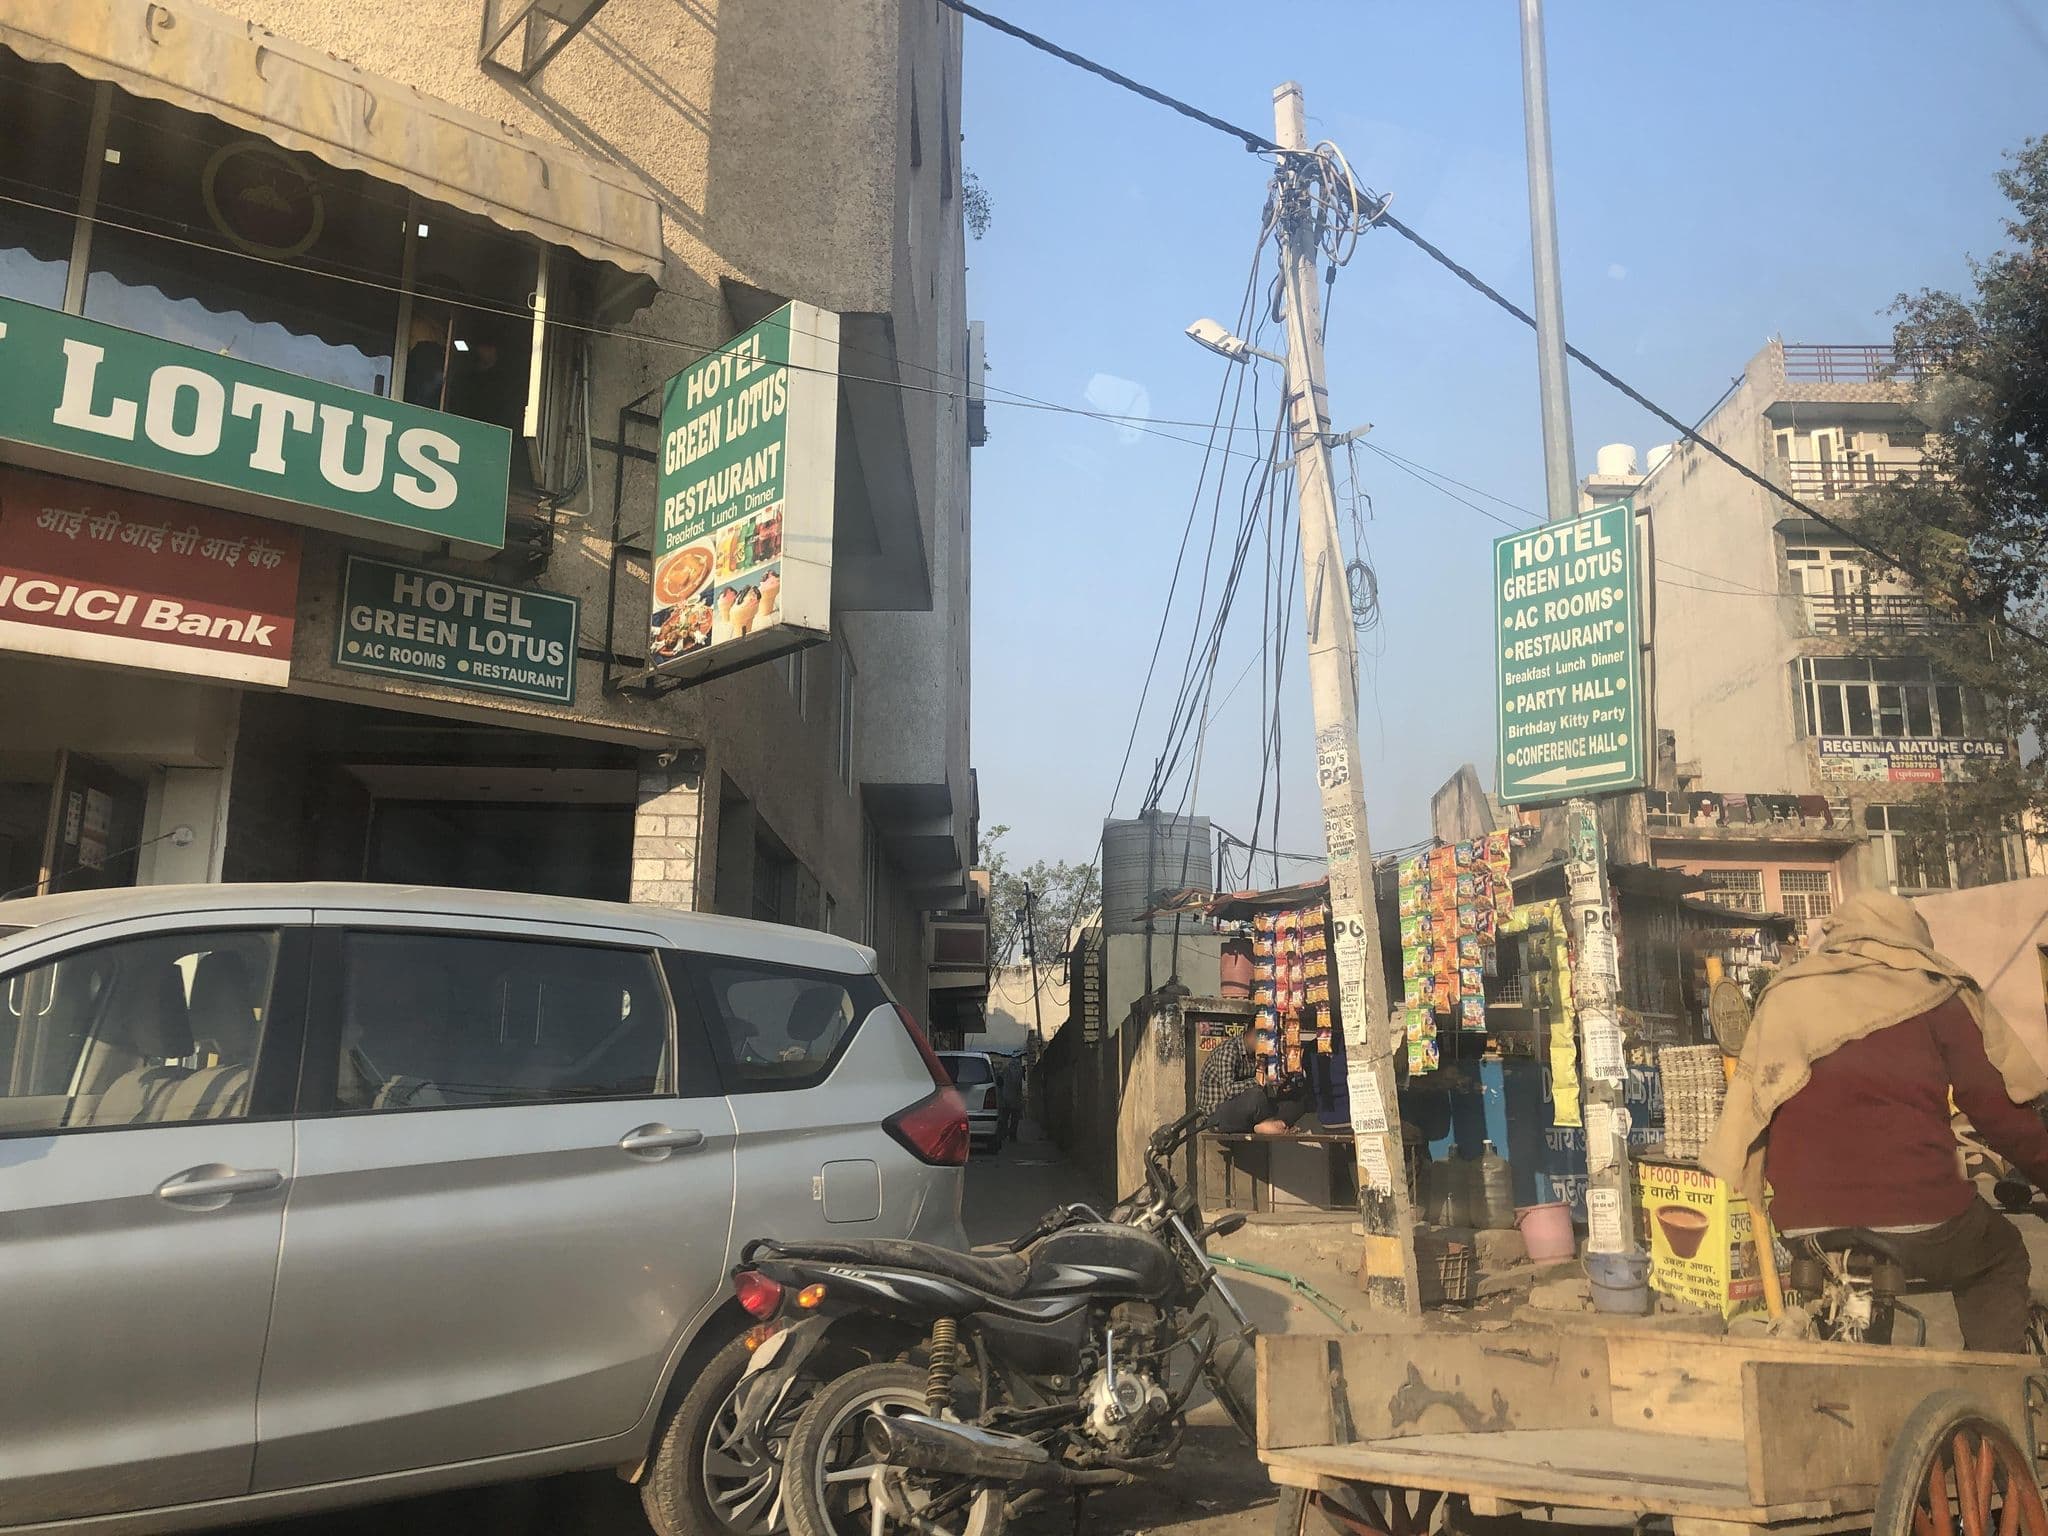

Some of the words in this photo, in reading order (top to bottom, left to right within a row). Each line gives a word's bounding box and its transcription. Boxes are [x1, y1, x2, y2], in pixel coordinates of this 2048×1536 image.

[687, 334, 765, 410] HOTEL
[52, 339, 459, 509] LOTUS
[666, 405, 721, 475] GREEN
[726, 368, 787, 445] LOTUS
[664, 442, 781, 531] RESTAURANT
[666, 519, 705, 549] Breakfast
[711, 503, 738, 527] Lunch
[744, 487, 776, 512] Dinner
[1514, 519, 1611, 569] HOTEL
[1504, 565, 1559, 601] GREEN
[1565, 549, 1622, 586] LOTUS
[0, 576, 138, 625] ICICI
[141, 599, 277, 646] Bank
[393, 573, 532, 628] HOTEL
[1514, 606, 1538, 631] AC
[1545, 586, 1613, 623] ROOMS
[351, 605, 458, 647] GREEN
[468, 627, 564, 666] LOTUS
[1515, 620, 1613, 661] RESTAURANT
[363, 643, 384, 659] AC
[390, 647, 446, 669] ROOMS
[473, 662, 564, 689] RESTAURANT
[1505, 664, 1551, 686] Breakfast
[1556, 656, 1586, 675] Lunch
[1591, 650, 1625, 669] Dinner
[1517, 687, 1566, 714] PARTY
[1572, 678, 1614, 704] HALL
[1508, 717, 1556, 739] Birthday
[1560, 713, 1589, 731] Kitty
[1592, 706, 1626, 725] Party
[1319, 752, 1345, 767] Boy's
[1516, 739, 1586, 767] CONFERENCE
[1589, 731, 1617, 754] HALL
[1823, 740, 1893, 754] REGENMA
[1900, 740, 1959, 755] NATURE
[1963, 741, 2004, 756] CARE
[1334, 919, 1364, 939] PG
[1650, 1167, 1680, 1185] FOOD
[1685, 1190, 1715, 1205] चाय
